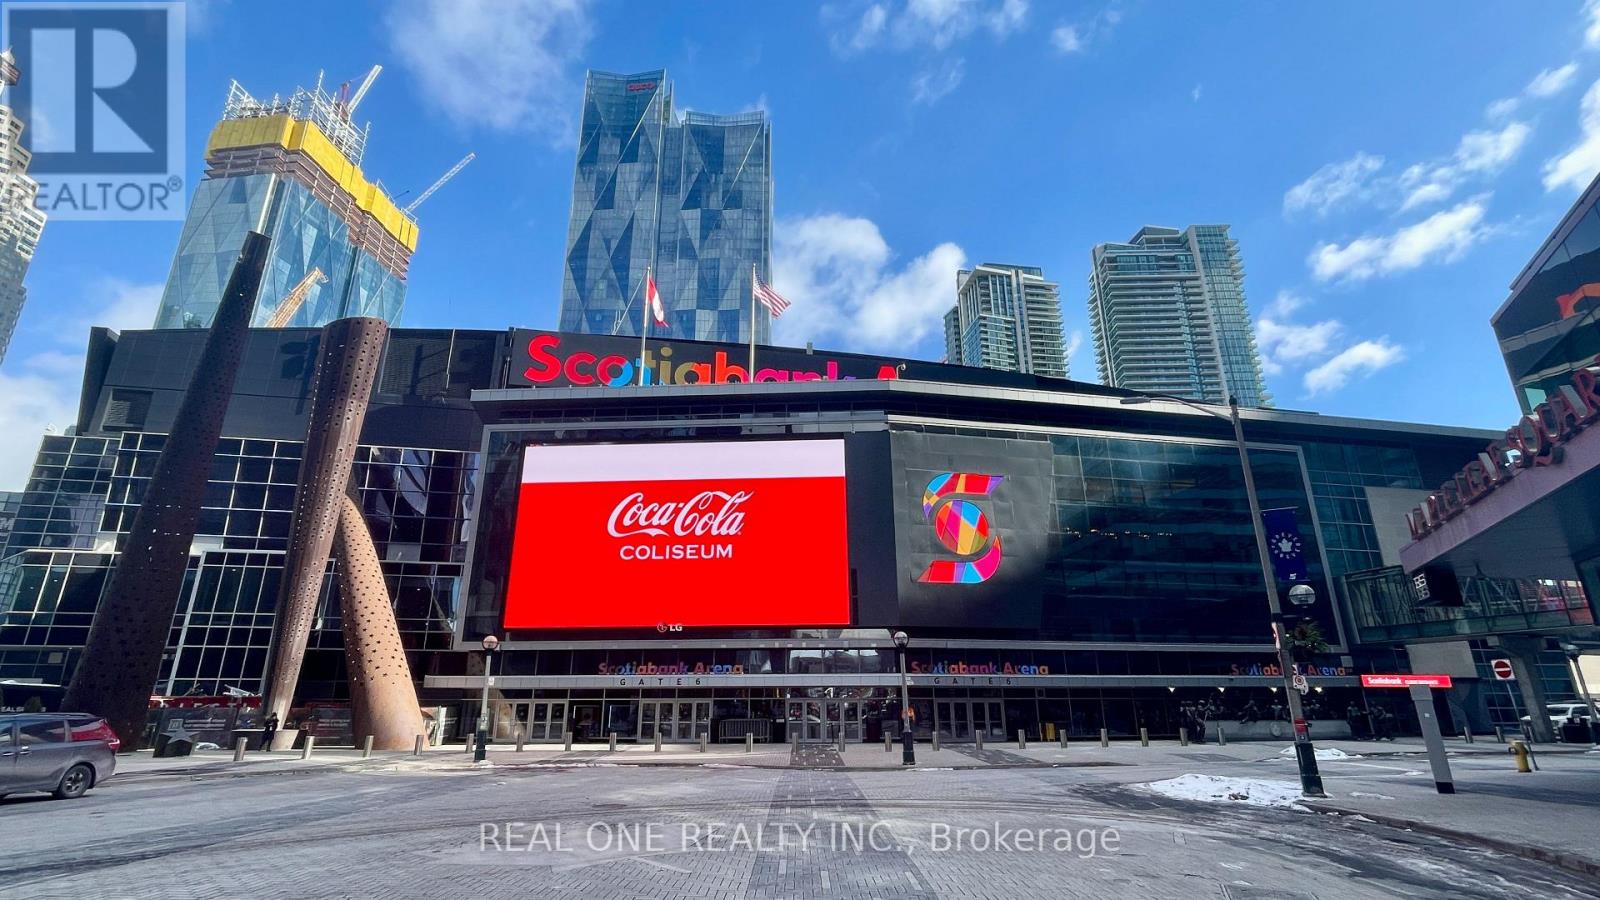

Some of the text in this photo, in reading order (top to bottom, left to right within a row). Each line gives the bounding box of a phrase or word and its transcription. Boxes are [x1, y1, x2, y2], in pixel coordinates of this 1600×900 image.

[607, 490, 755, 538] Coca-Cola
[619, 543, 733, 560] COLISEUM
[669, 624, 683, 632] LG
[598, 662, 744, 675] Scotiabank Arena
[911, 660, 1049, 675] Scotiabank Arena
